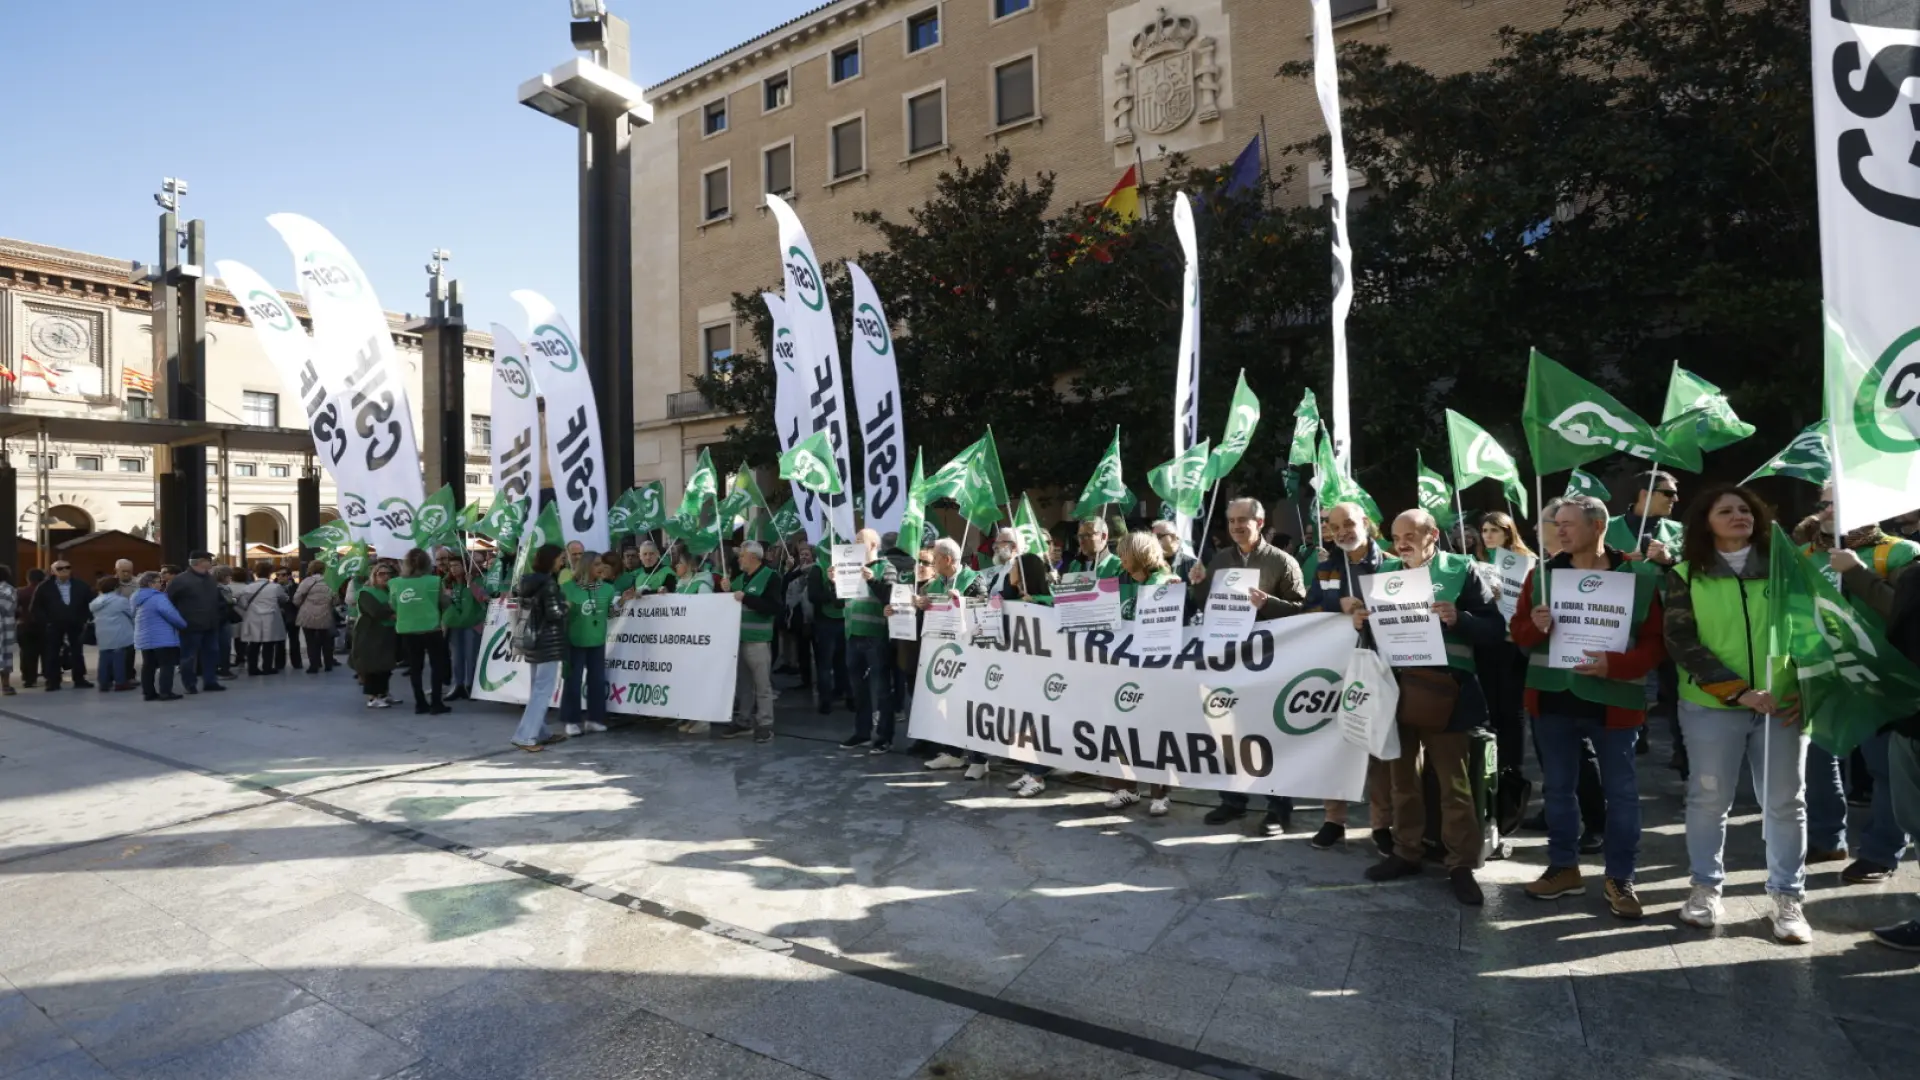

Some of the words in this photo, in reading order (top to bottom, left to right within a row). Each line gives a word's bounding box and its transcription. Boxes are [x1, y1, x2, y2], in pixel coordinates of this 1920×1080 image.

[1388, 581, 1404, 590] CSIF
[1583, 580, 1604, 588] CSIF
[638, 607, 669, 618] SALARIAL
[671, 606, 687, 617] YA!!
[1553, 601, 1559, 610] A
[1561, 601, 1584, 611] IGUAL
[1587, 603, 1627, 616] TRABAJO,
[1378, 616, 1400, 626] IGUAL
[1400, 613, 1430, 624] SALARIO
[1558, 616, 1581, 624] IGUAL
[1584, 616, 1620, 628] SALARIO
[659, 634, 711, 646] LABORALES
[978, 614, 1052, 658] UAL
[1064, 629, 1275, 672] TRAAJO
[604, 658, 640, 671] EMPLEO
[641, 658, 673, 673] PÚBLICO
[933, 657, 967, 679] CSIF
[989, 669, 1004, 682] CSIF
[1047, 680, 1067, 693] CSIF
[1119, 691, 1144, 705] CSIF
[1209, 695, 1239, 709] CSIF
[966, 700, 1063, 756] IGUAL
[1072, 719, 1274, 778] SALARIO
